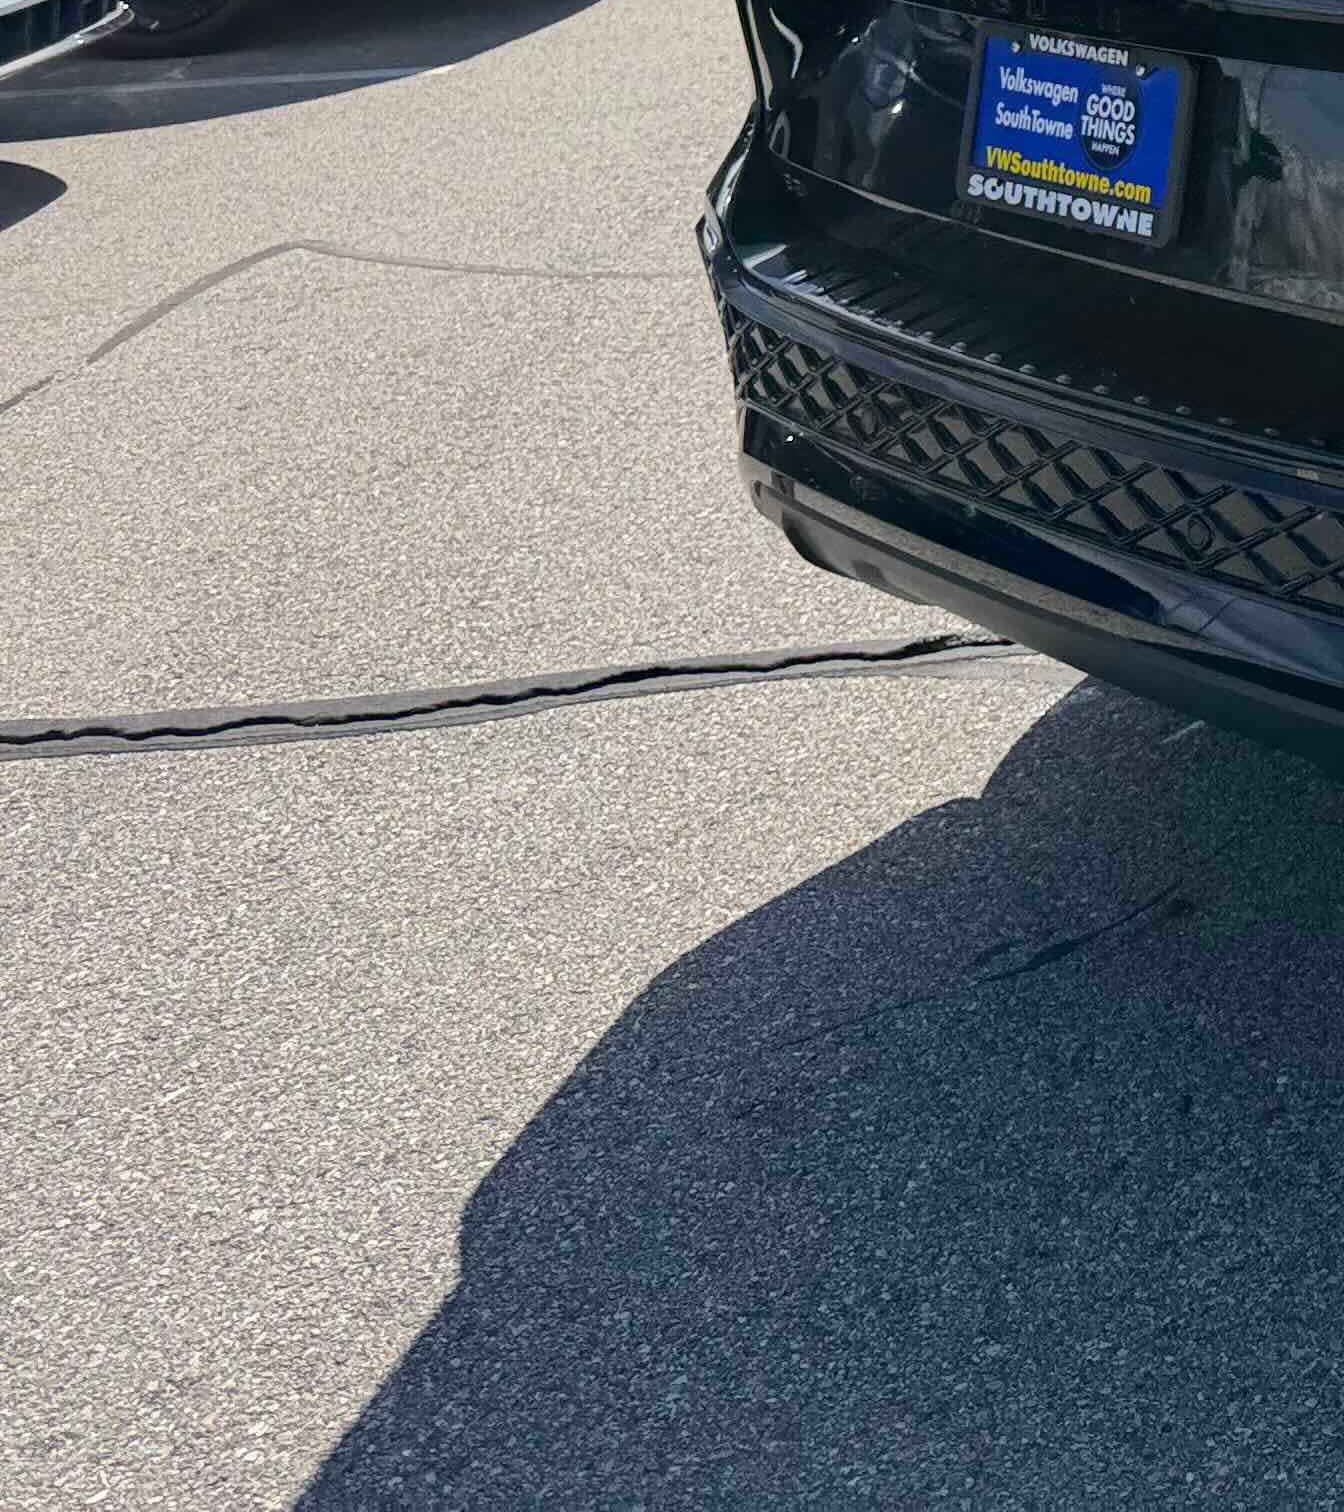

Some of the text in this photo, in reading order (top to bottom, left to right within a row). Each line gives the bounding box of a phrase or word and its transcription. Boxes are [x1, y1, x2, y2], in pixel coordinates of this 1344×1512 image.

[1029, 33, 1129, 67] VOLKSWAGEN
[1000, 66, 1079, 106] Volkswagen
[995, 101, 1073, 140] SouthTowne
[1086, 94, 1136, 122] GOOD
[1081, 115, 1136, 145] THINGS
[986, 145, 1152, 204] VWSouthtowne.com
[967, 174, 1154, 237] SOUTHTOWNE
